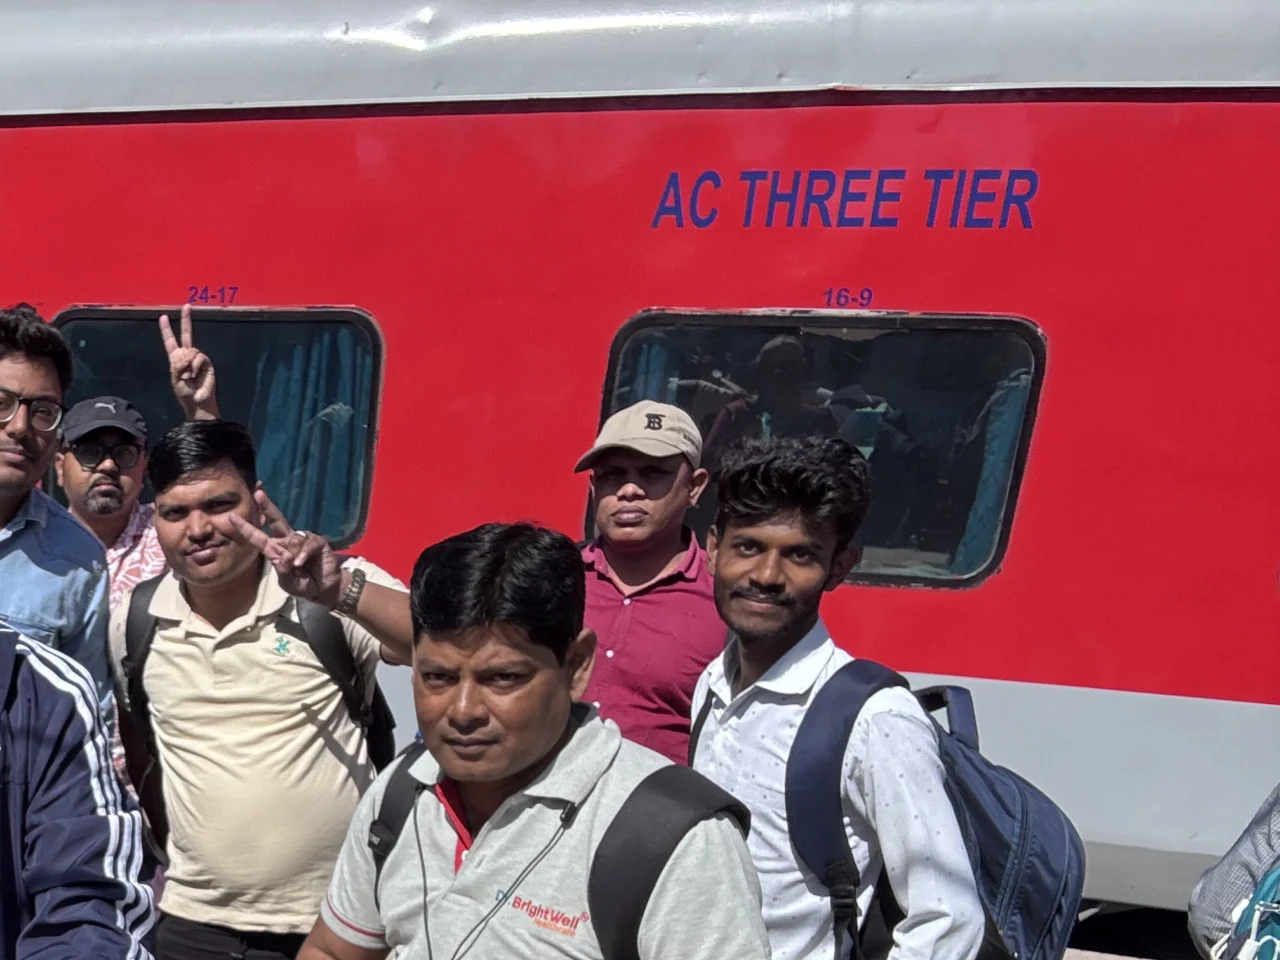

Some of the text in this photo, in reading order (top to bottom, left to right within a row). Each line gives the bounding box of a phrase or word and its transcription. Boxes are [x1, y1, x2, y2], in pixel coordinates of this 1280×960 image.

[651, 169, 1039, 229] AC THREE TIER
[187, 286, 239, 304] 24-17
[822, 287, 873, 308] 16-9
[512, 895, 580, 930] BrightWell
